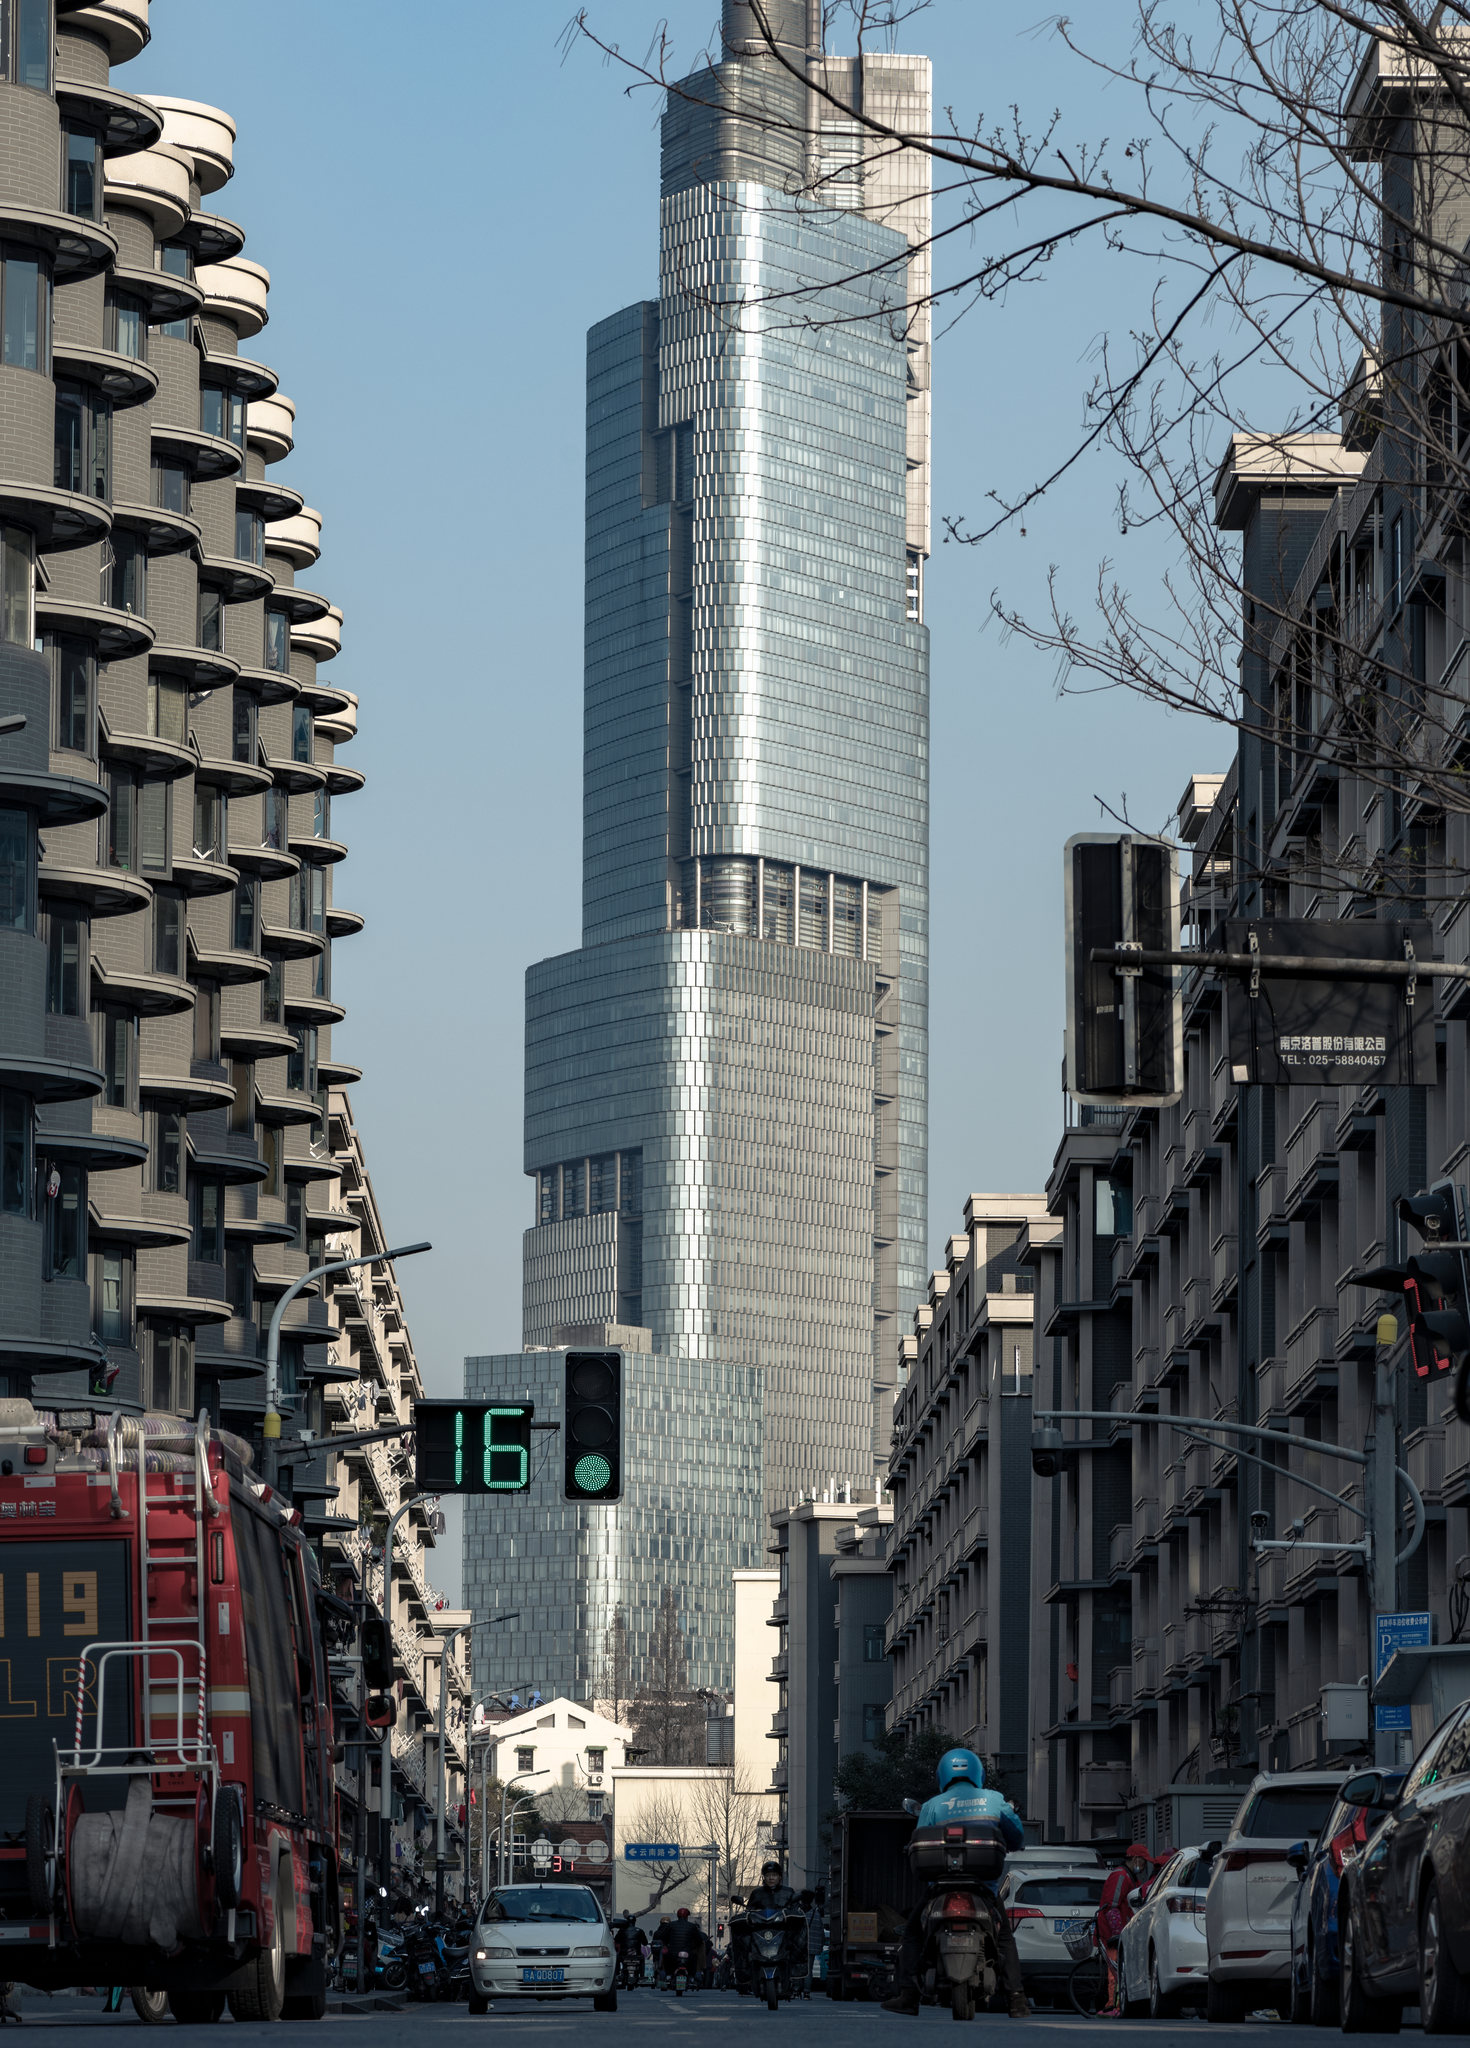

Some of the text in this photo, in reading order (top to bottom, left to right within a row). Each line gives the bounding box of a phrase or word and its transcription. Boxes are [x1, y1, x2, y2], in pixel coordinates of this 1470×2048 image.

[1280, 1036, 1386, 1051] 南京洛普股份有限公司
[455, 1408, 527, 1489] 16
[1381, 1634, 1391, 1653] P
[639, 1848, 665, 1857] 云南路
[553, 1855, 574, 1873] 31
